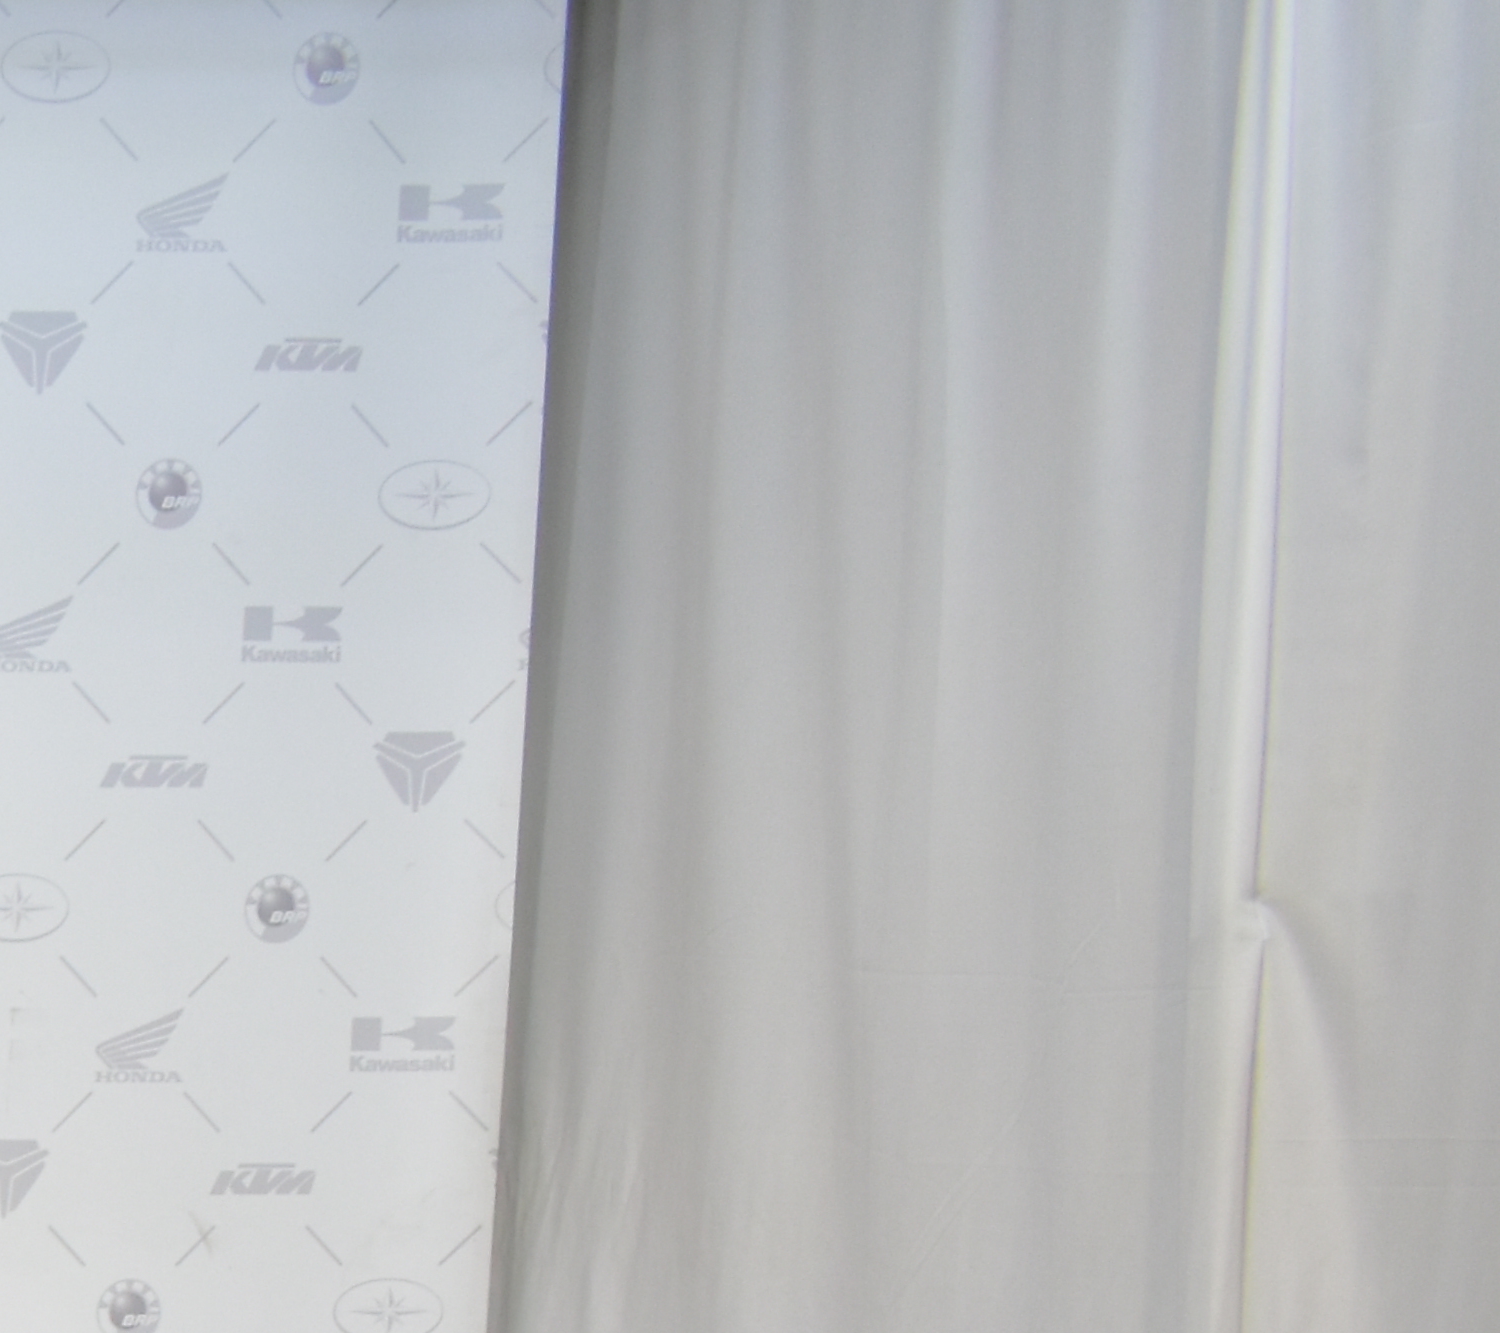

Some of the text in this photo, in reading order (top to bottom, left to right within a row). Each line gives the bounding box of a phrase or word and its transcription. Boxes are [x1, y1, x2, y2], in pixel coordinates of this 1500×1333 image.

[397, 224, 504, 244] Kawasaki
[136, 239, 227, 253] HONDA
[254, 337, 363, 372] KTM
[241, 644, 342, 664] Kawasaki
[100, 754, 209, 788] KTM
[349, 1054, 456, 1073] Kawasaki
[95, 1070, 183, 1084] HONDA
[210, 1163, 317, 1196] KTM
